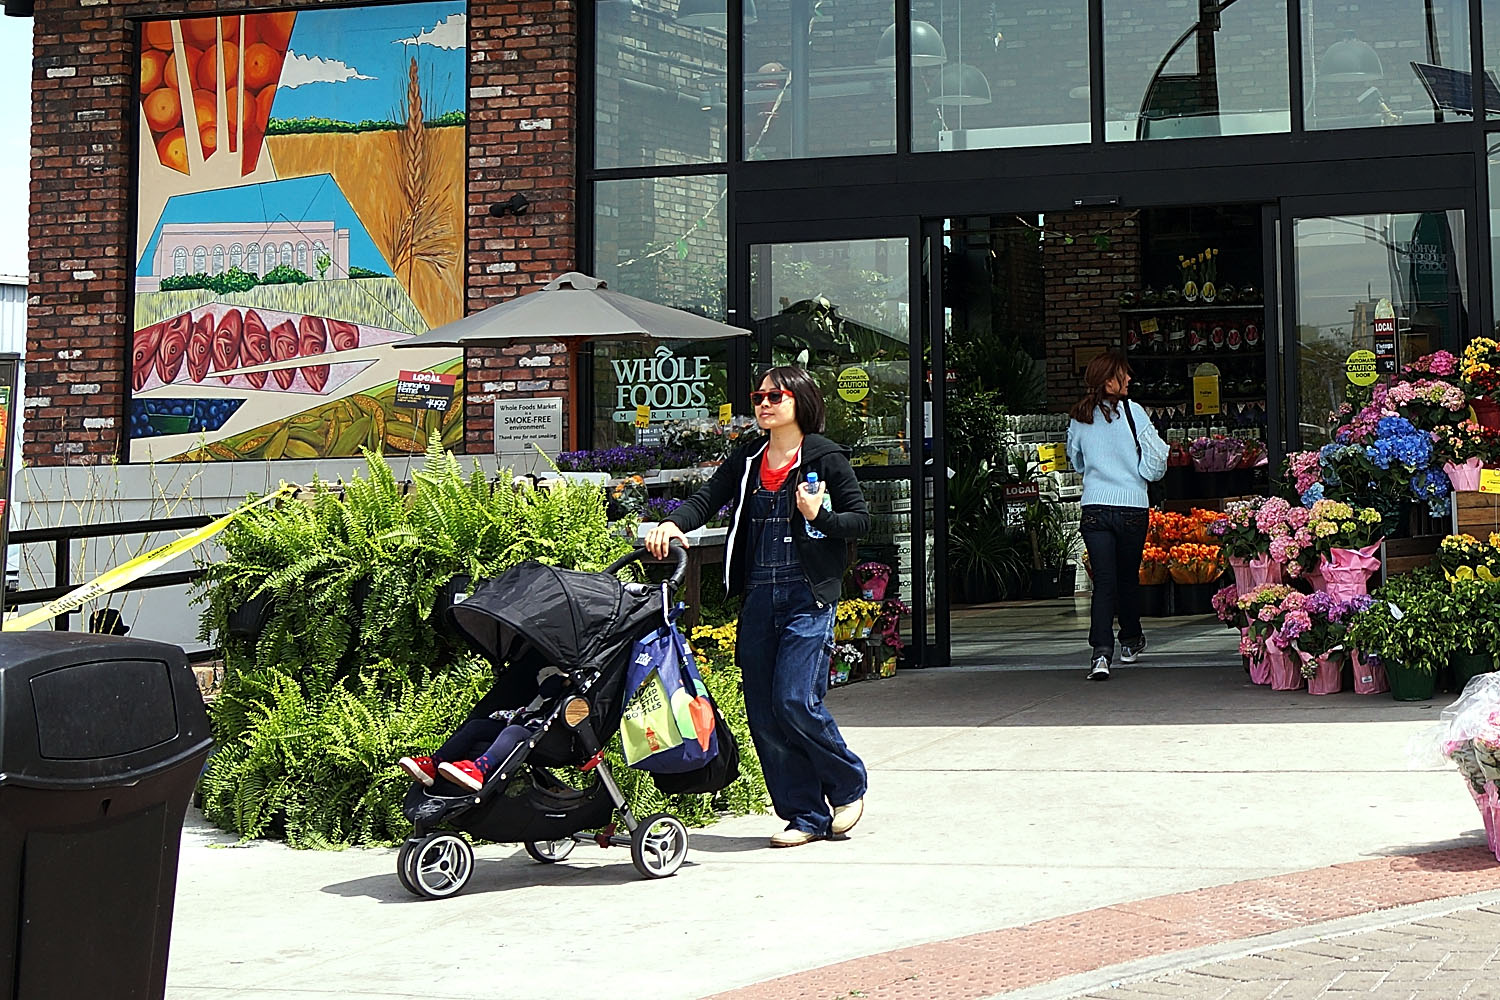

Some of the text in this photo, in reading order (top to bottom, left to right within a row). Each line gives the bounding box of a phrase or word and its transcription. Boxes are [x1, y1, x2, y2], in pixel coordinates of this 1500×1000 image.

[1375, 322, 1394, 332] LOCAL
[610, 345, 711, 384] WHOLE
[1347, 364, 1377, 372] CAUTION
[412, 373, 441, 383] LOCAL
[616, 382, 706, 409] FOODS
[504, 416, 552, 424] SMOKE-FREE
[619, 411, 702, 420] MRKET
[1006, 485, 1037, 495] LOCAL
